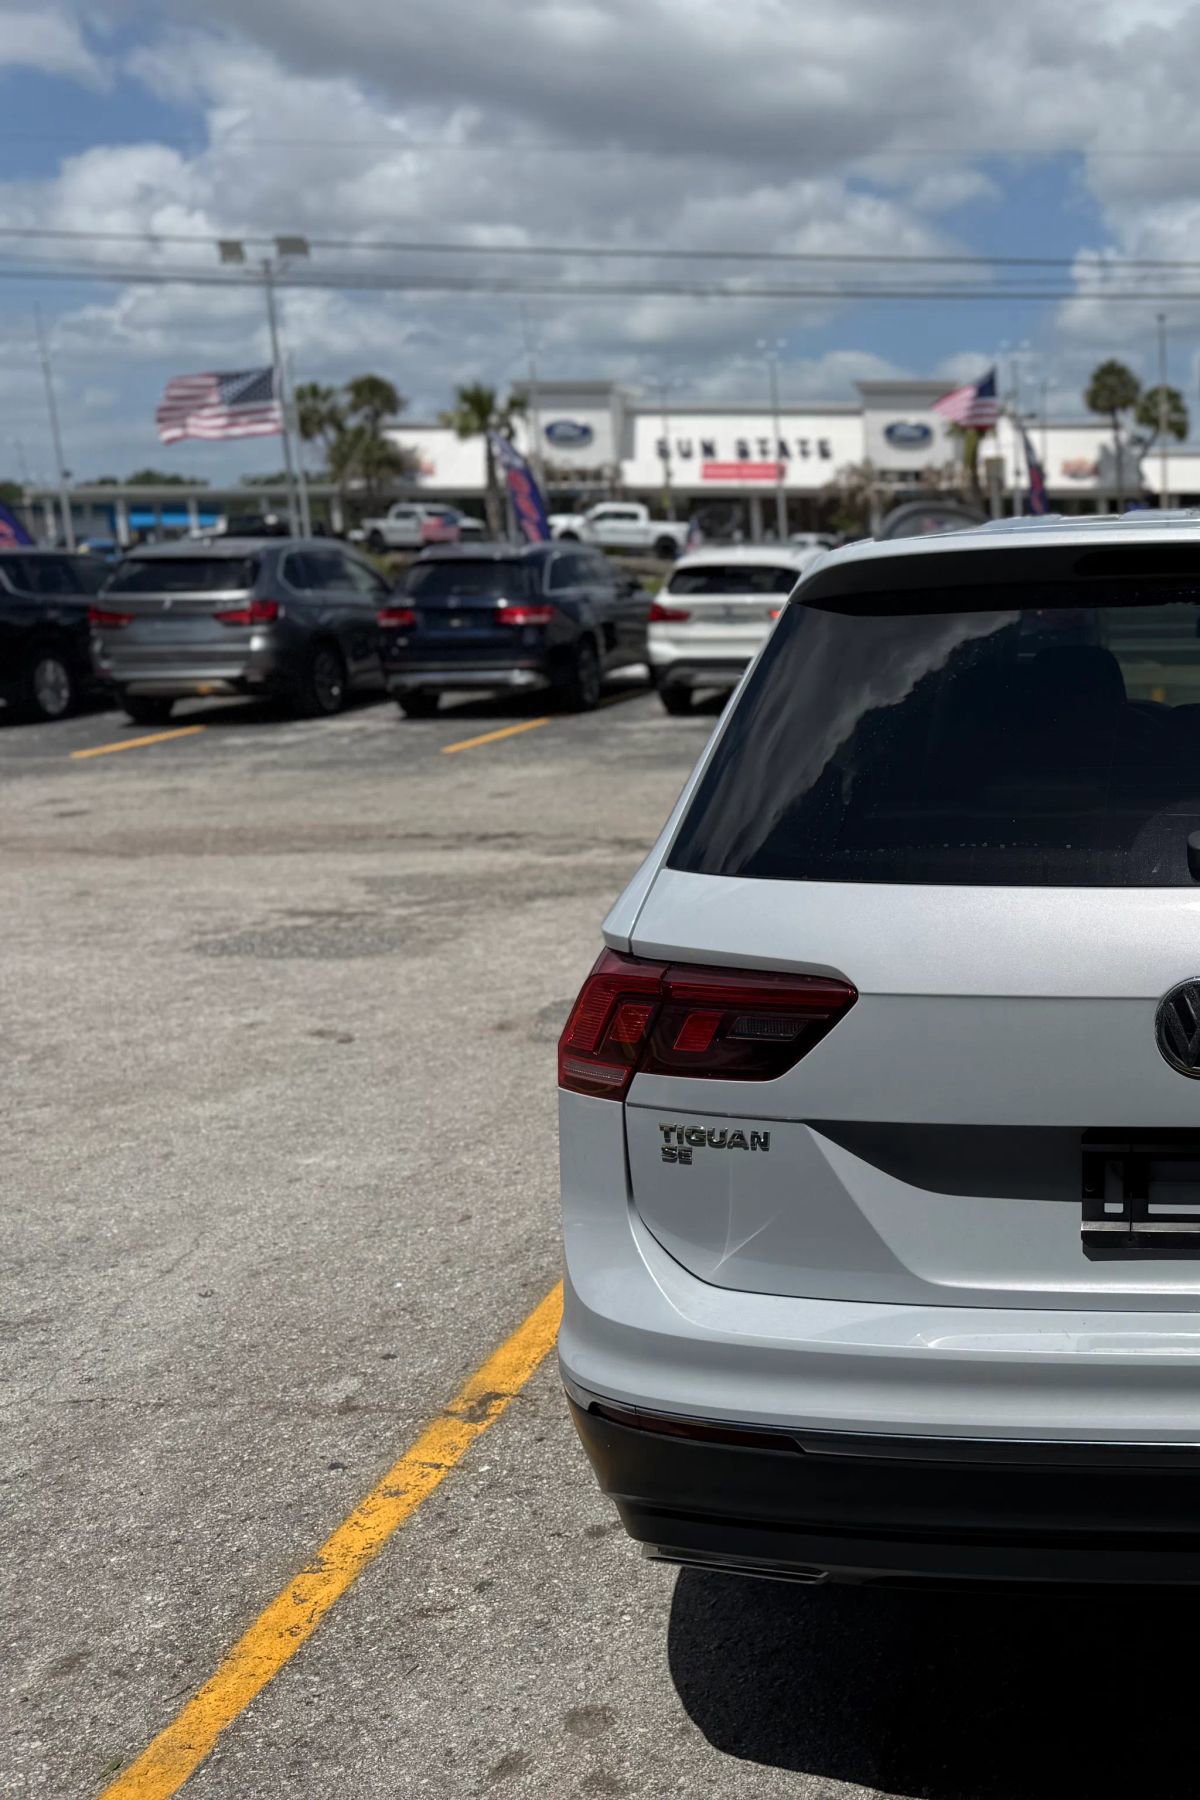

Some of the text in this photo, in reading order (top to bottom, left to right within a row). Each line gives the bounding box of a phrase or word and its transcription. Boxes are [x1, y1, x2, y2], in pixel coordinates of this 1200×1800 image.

[656, 437, 833, 460] SUN STATE
[659, 1123, 771, 1152] TIGUAN
[661, 1146, 693, 1165] SE
